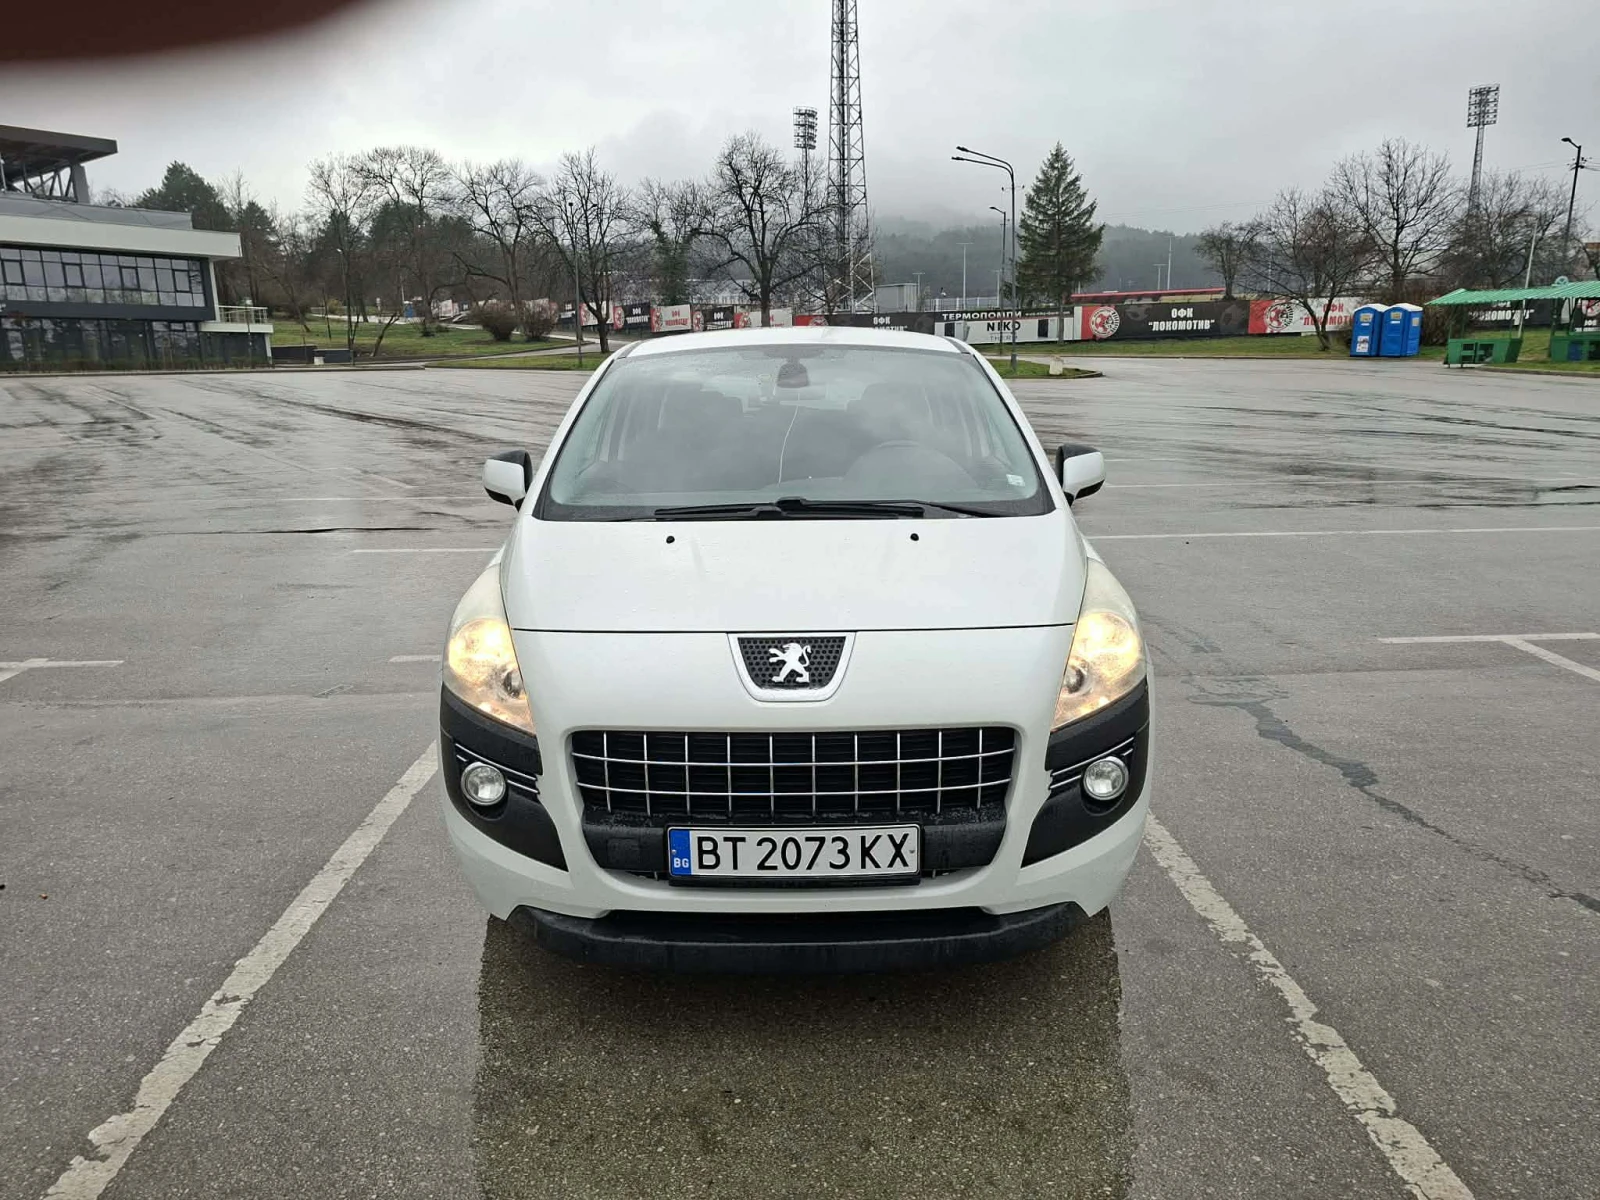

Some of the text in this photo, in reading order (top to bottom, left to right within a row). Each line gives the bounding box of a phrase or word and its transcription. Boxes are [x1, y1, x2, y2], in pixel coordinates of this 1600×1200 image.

[1171, 307, 1194, 318] ОФК
[697, 832, 910, 871] BT 2073 KX
[673, 857, 690, 868] BG
